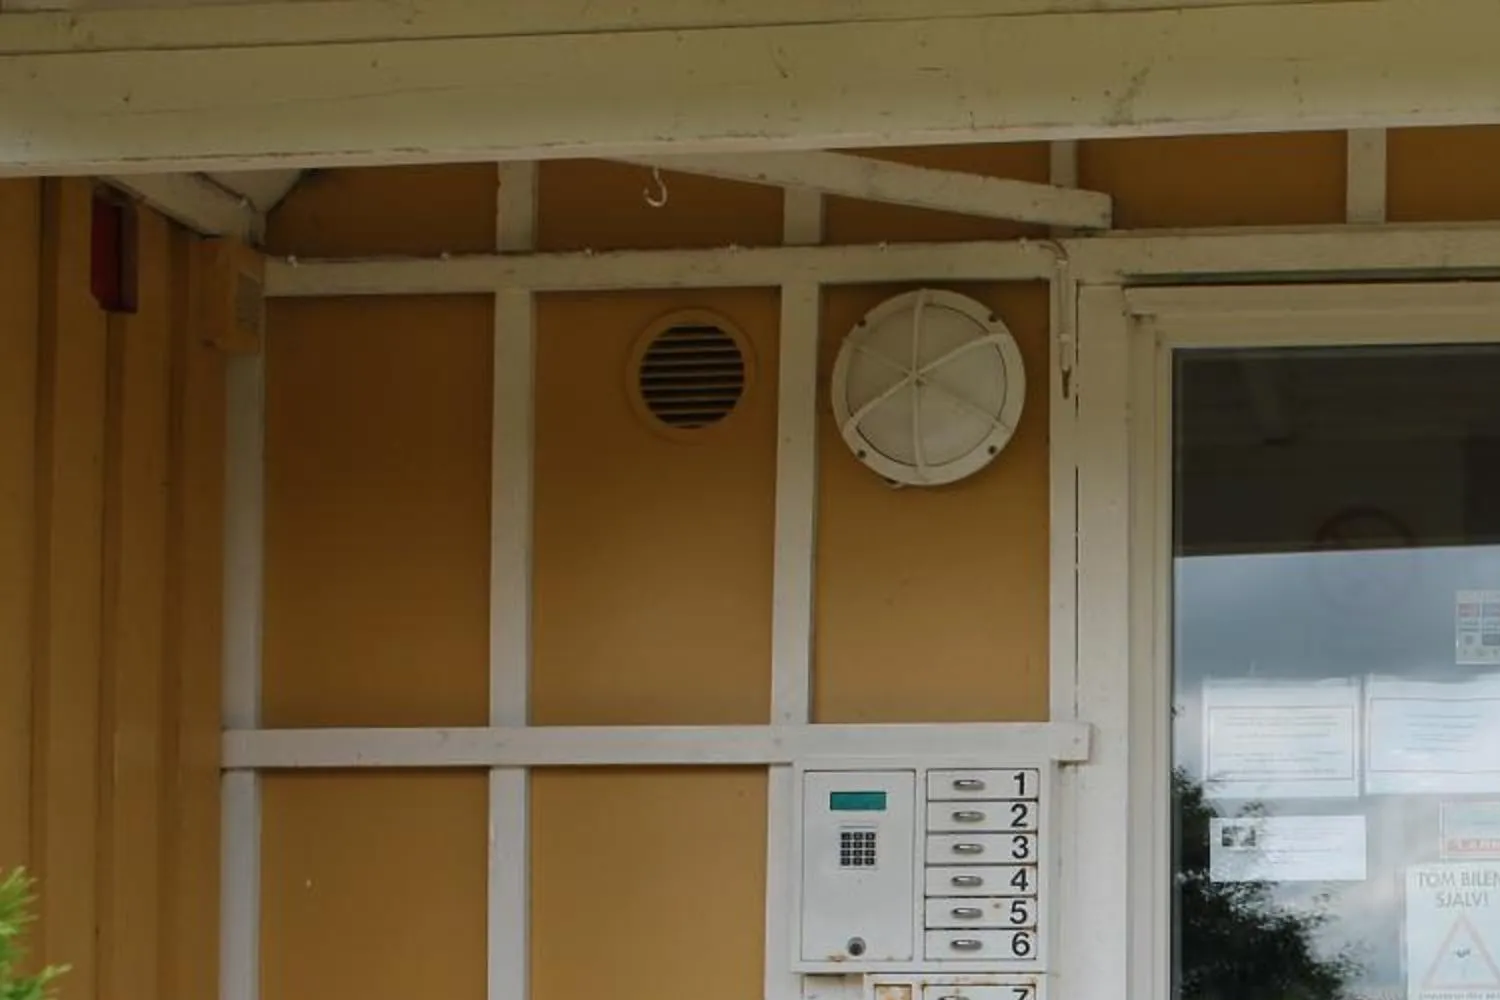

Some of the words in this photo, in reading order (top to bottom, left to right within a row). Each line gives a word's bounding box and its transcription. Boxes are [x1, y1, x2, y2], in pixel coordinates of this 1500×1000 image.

[1013, 772, 1026, 796] 1
[1010, 803, 1029, 827] 2
[1011, 835, 1029, 859] 3
[1010, 868, 1029, 891] 4
[1417, 871, 1455, 888] TOM
[1009, 900, 1028, 924] 5
[1011, 932, 1030, 956] 6
